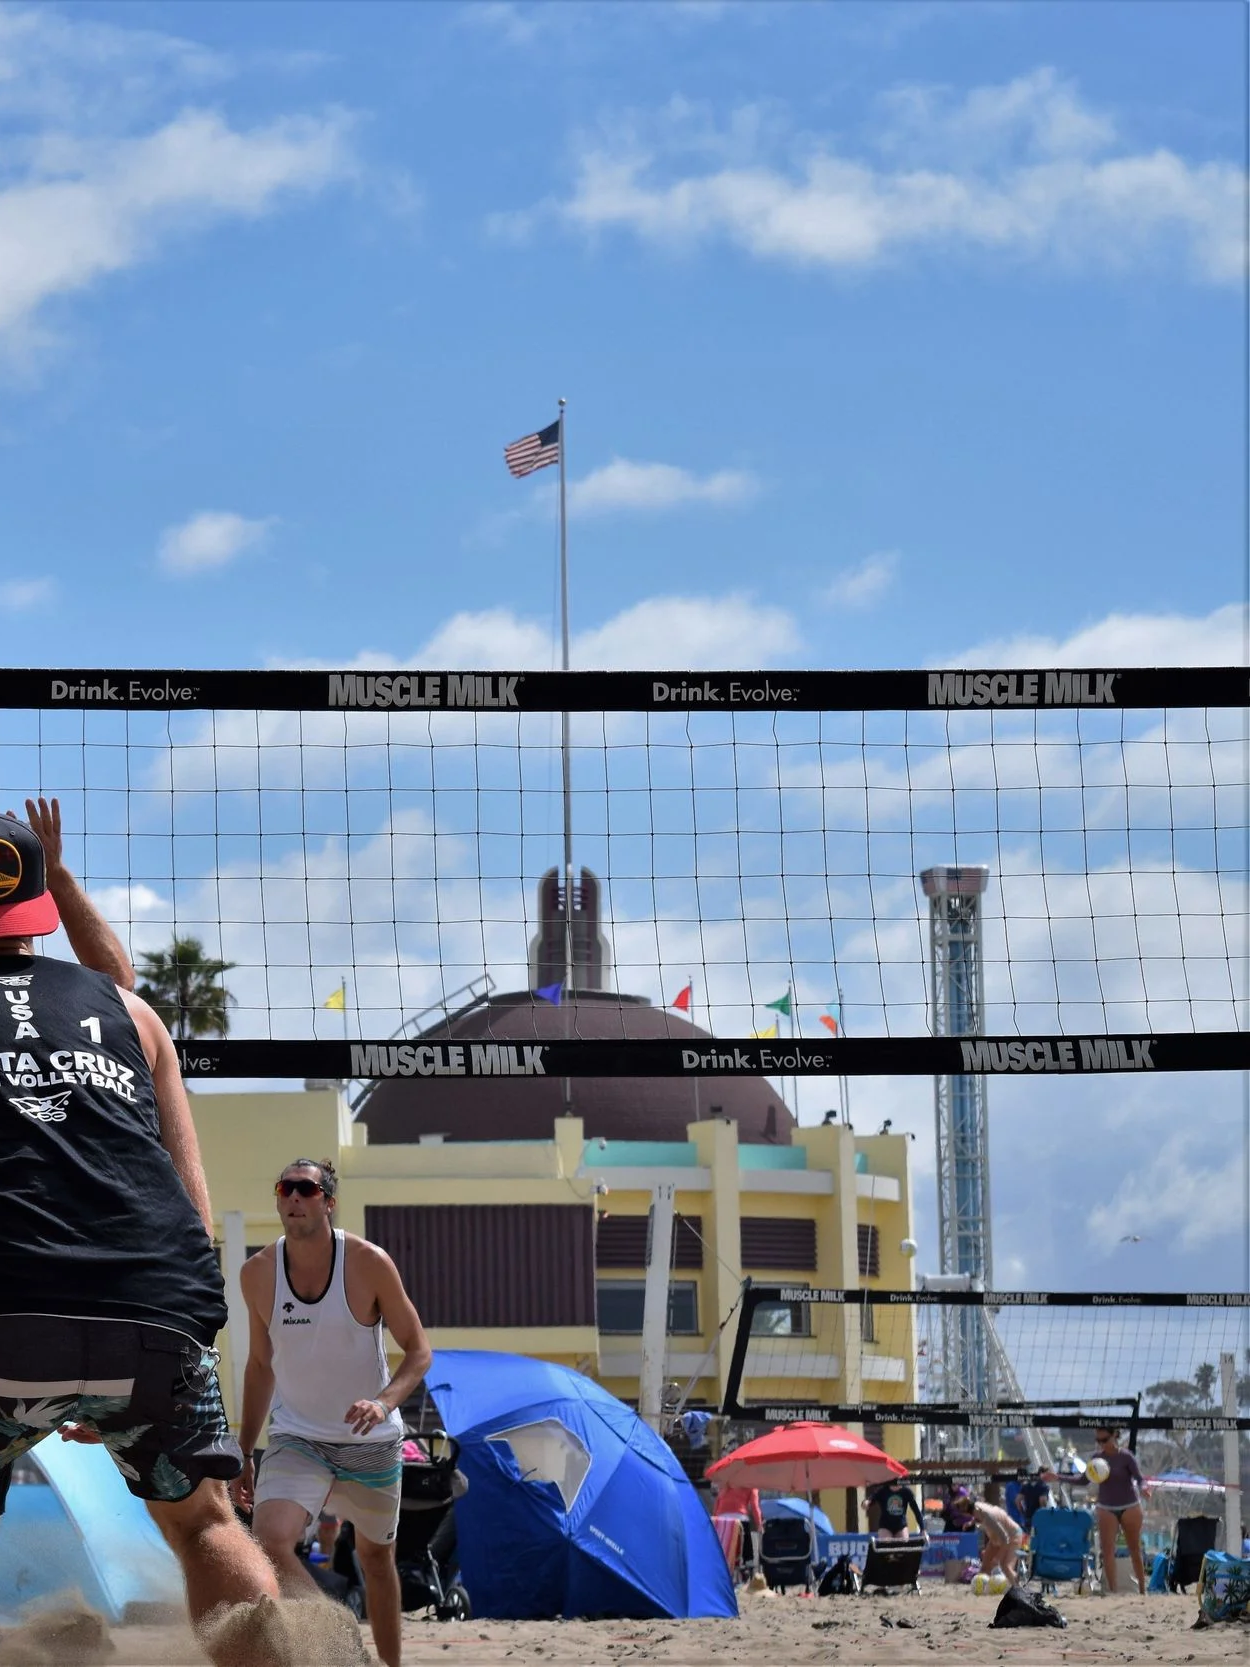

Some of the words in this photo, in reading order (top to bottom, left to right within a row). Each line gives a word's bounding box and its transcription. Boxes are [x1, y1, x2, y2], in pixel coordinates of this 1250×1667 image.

[51, 680, 124, 701] Drink.
[328, 674, 441, 707] MUSCLE
[447, 674, 519, 707] MILK
[653, 682, 725, 702] Drink.
[928, 673, 1039, 705] MUSCLE
[1044, 671, 1115, 704] MILK
[5, 990, 40, 1040] USA
[80, 1016, 102, 1044] 1
[351, 1045, 465, 1077] MUSCLE
[471, 1045, 546, 1076] MILK
[682, 1050, 757, 1070] Drink.
[960, 1040, 1076, 1072] MUSCLE
[1081, 1038, 1155, 1070] MILK
[49, 1051, 135, 1091] CRUZ
[6, 1071, 138, 1103] VOLLEYBALL
[780, 1288, 819, 1301] MUSCLE
[821, 1289, 845, 1302] MILK
[983, 1292, 1022, 1304] MUSCLE
[1023, 1293, 1048, 1305] MILK
[1186, 1293, 1225, 1306] MUSCLE
[765, 1409, 805, 1421] MUSCLE
[806, 1409, 830, 1422] MILK
[969, 1414, 1008, 1427] MUSCLE
[1009, 1415, 1034, 1427] MILK
[1172, 1418, 1212, 1430] MUSCLE
[1213, 1418, 1237, 1430] MILK
